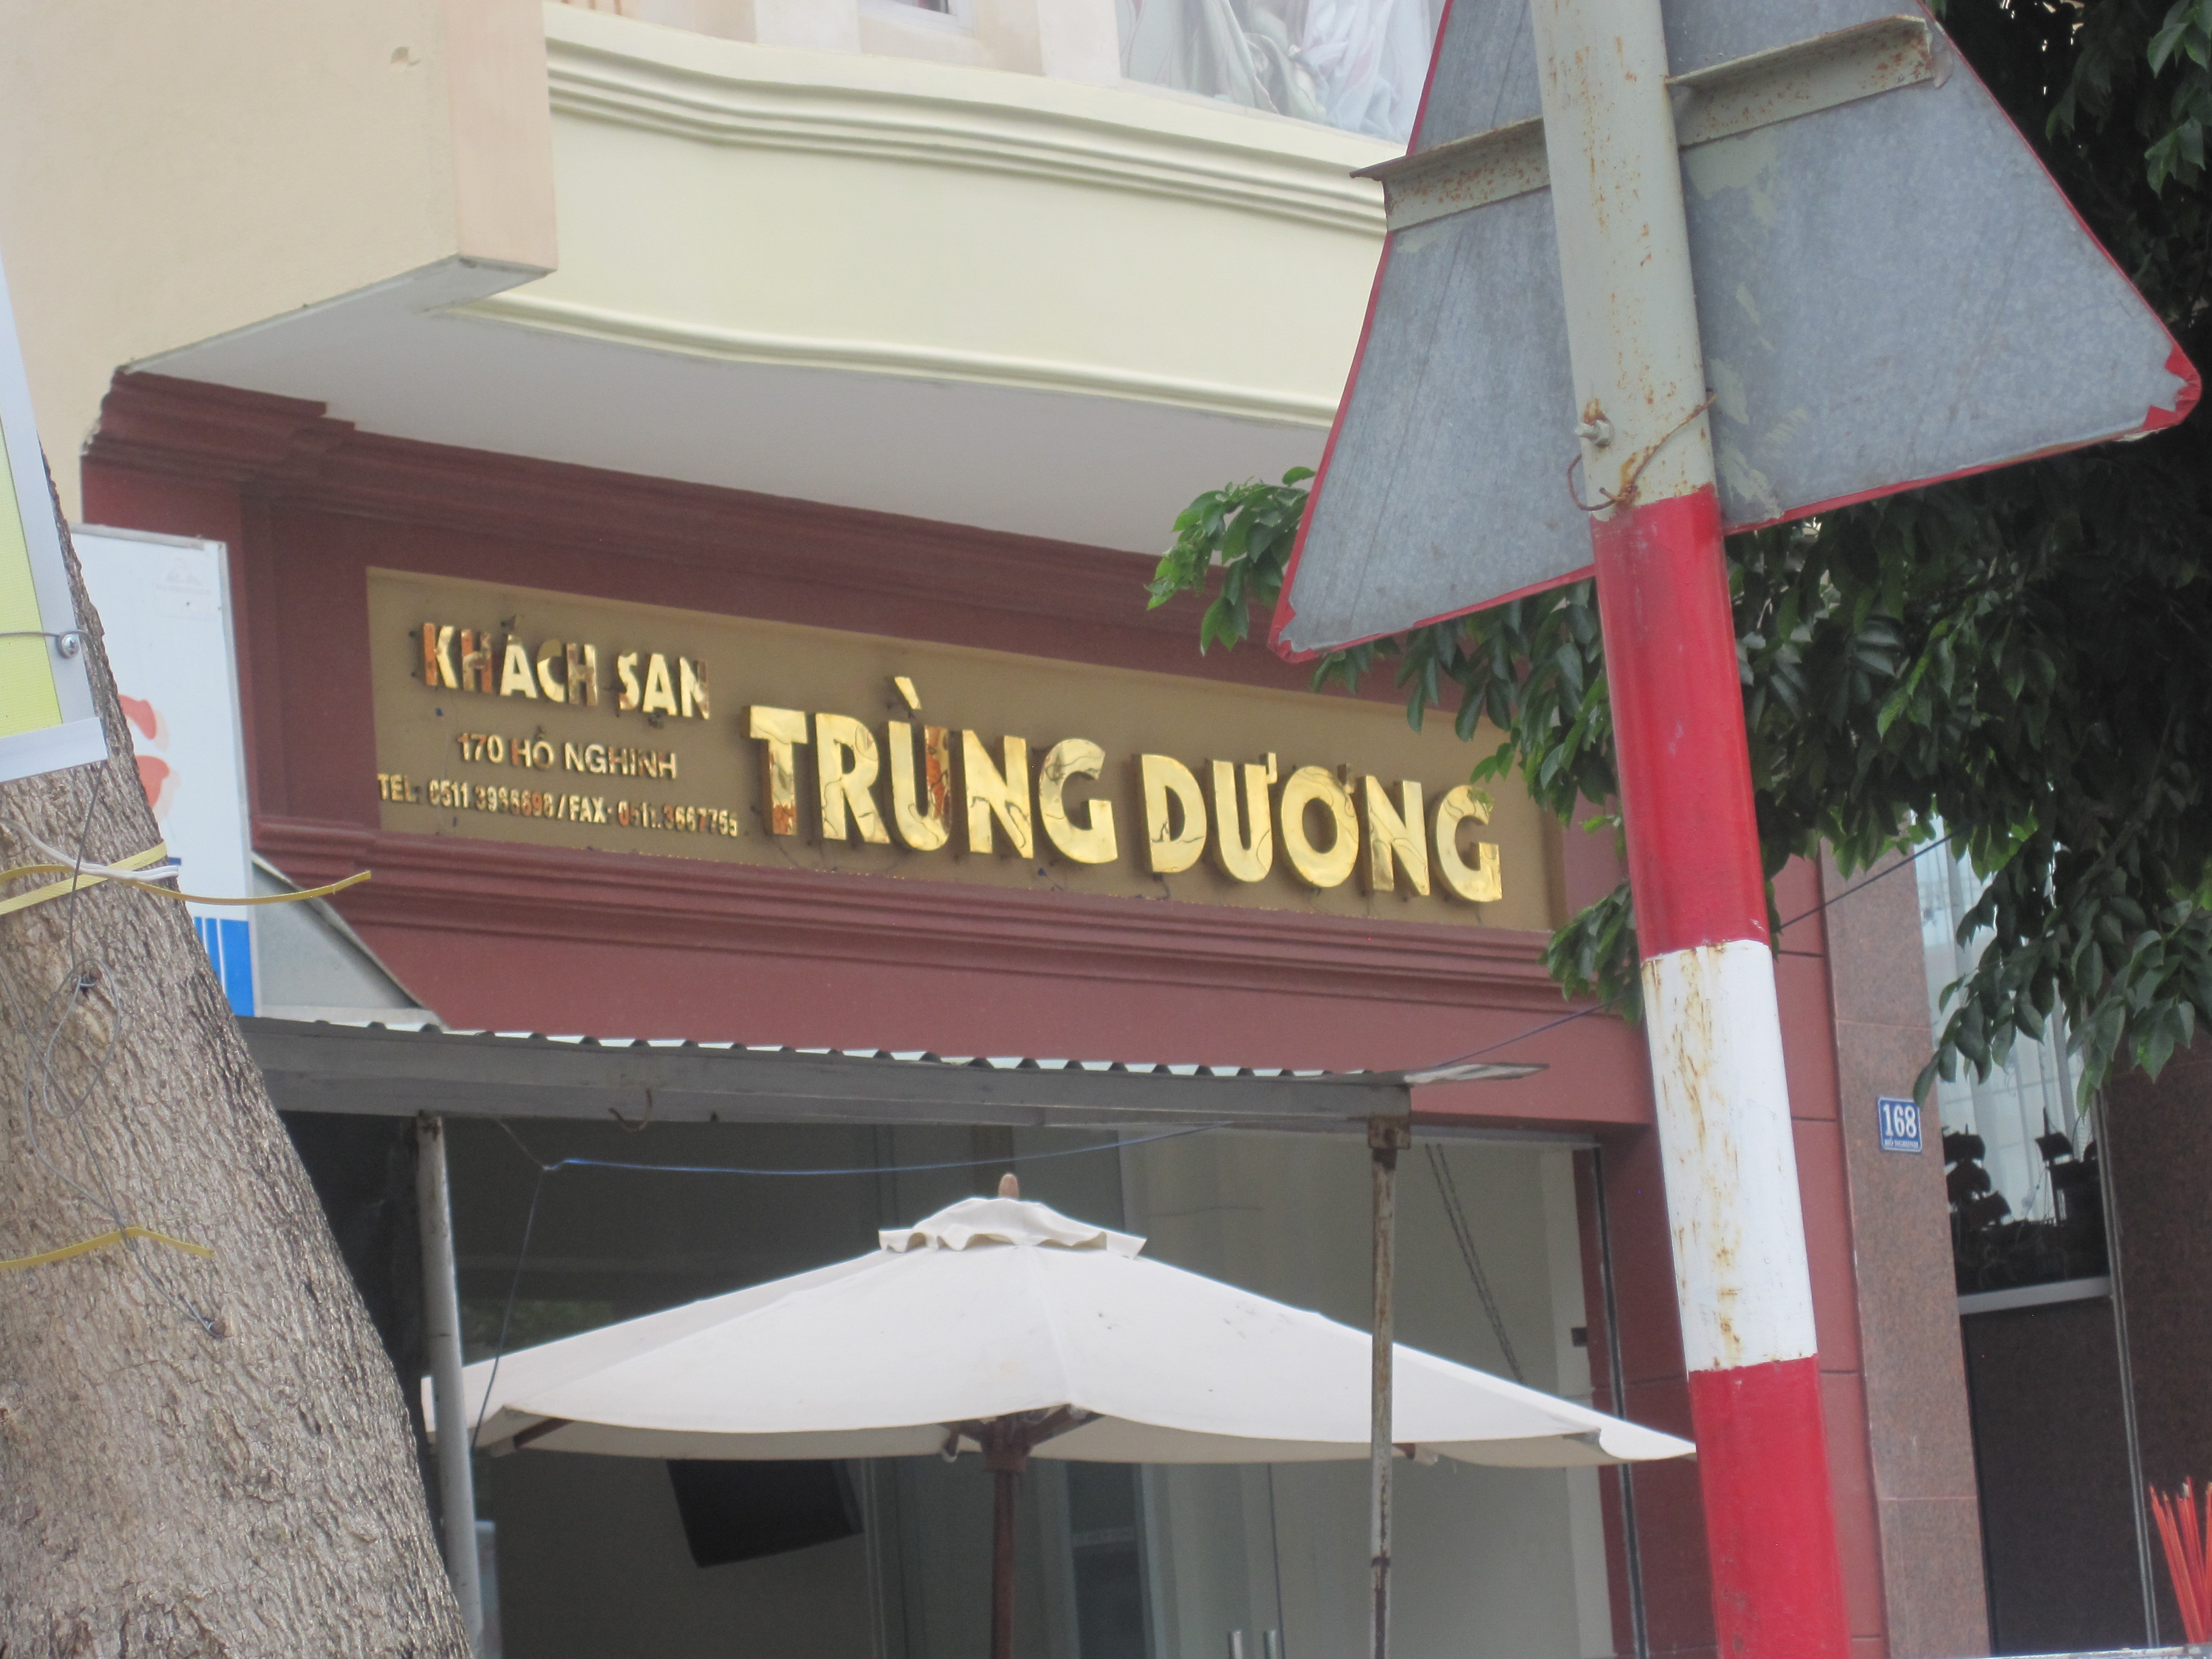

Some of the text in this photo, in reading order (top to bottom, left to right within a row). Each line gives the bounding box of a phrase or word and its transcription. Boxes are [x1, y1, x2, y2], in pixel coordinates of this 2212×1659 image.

[423, 614, 599, 706] KHÁCH
[457, 732, 504, 763] 170
[564, 741, 677, 780] NGHINH
[428, 779, 469, 809] 0511
[746, 675, 1504, 903] TRÙNG DƯƠNG
[1883, 1103, 1917, 1139] 168
